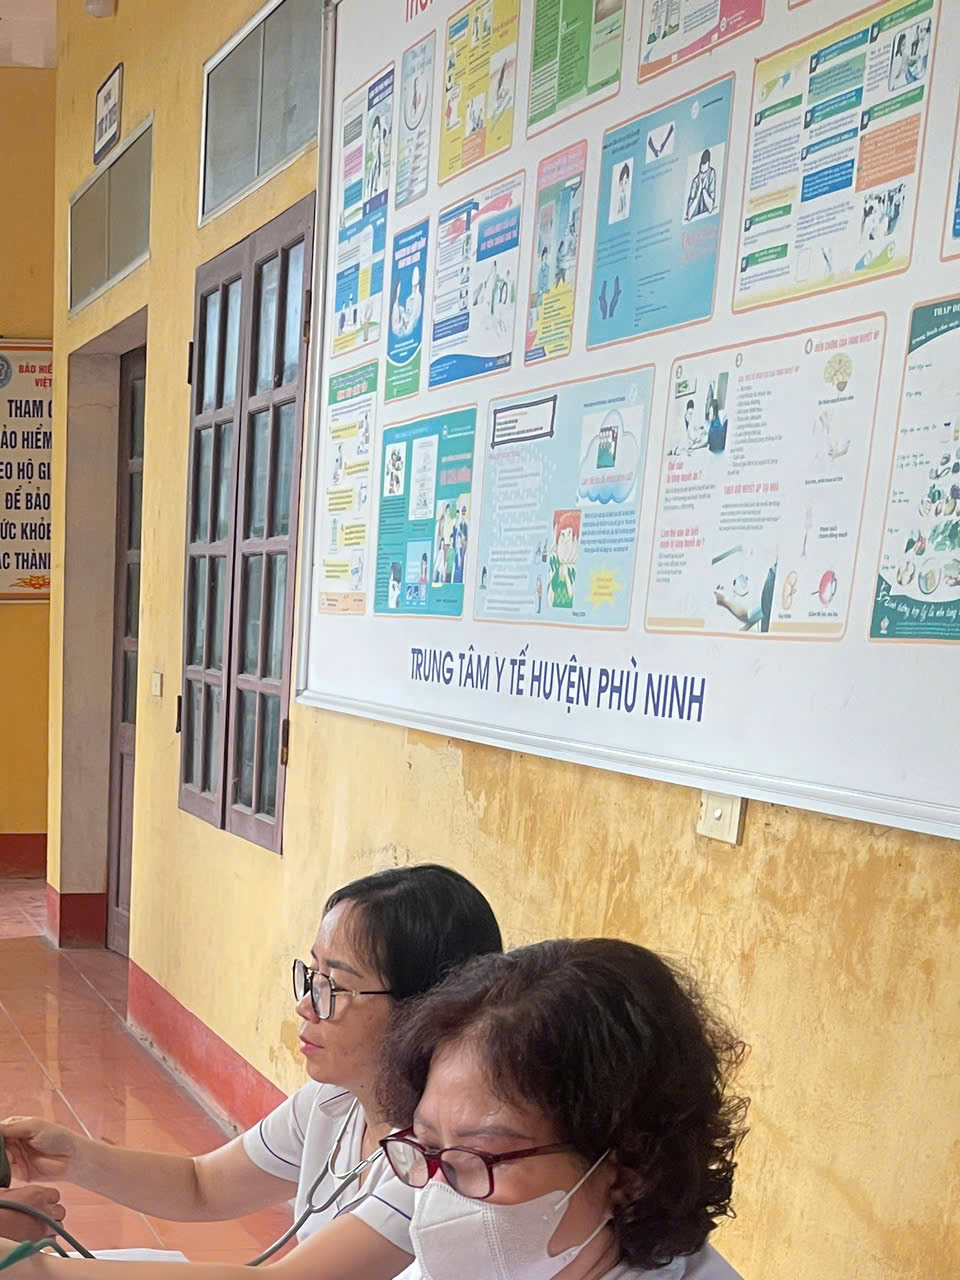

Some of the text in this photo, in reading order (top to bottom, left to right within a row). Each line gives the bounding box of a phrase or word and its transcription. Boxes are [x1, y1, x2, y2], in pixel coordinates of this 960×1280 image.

[19, 361, 52, 373] BẢO HIỂ
[7, 400, 43, 418] THAM
[22, 424, 52, 449] HIỂM
[17, 458, 34, 484] HỘ
[38, 462, 51, 480] GI
[5, 485, 51, 511] ĐỂ BẢO
[15, 548, 51, 569] THÀN
[411, 643, 706, 722] TRUNG TÂM Y TẾ HUYỆN PHÙ NINH
